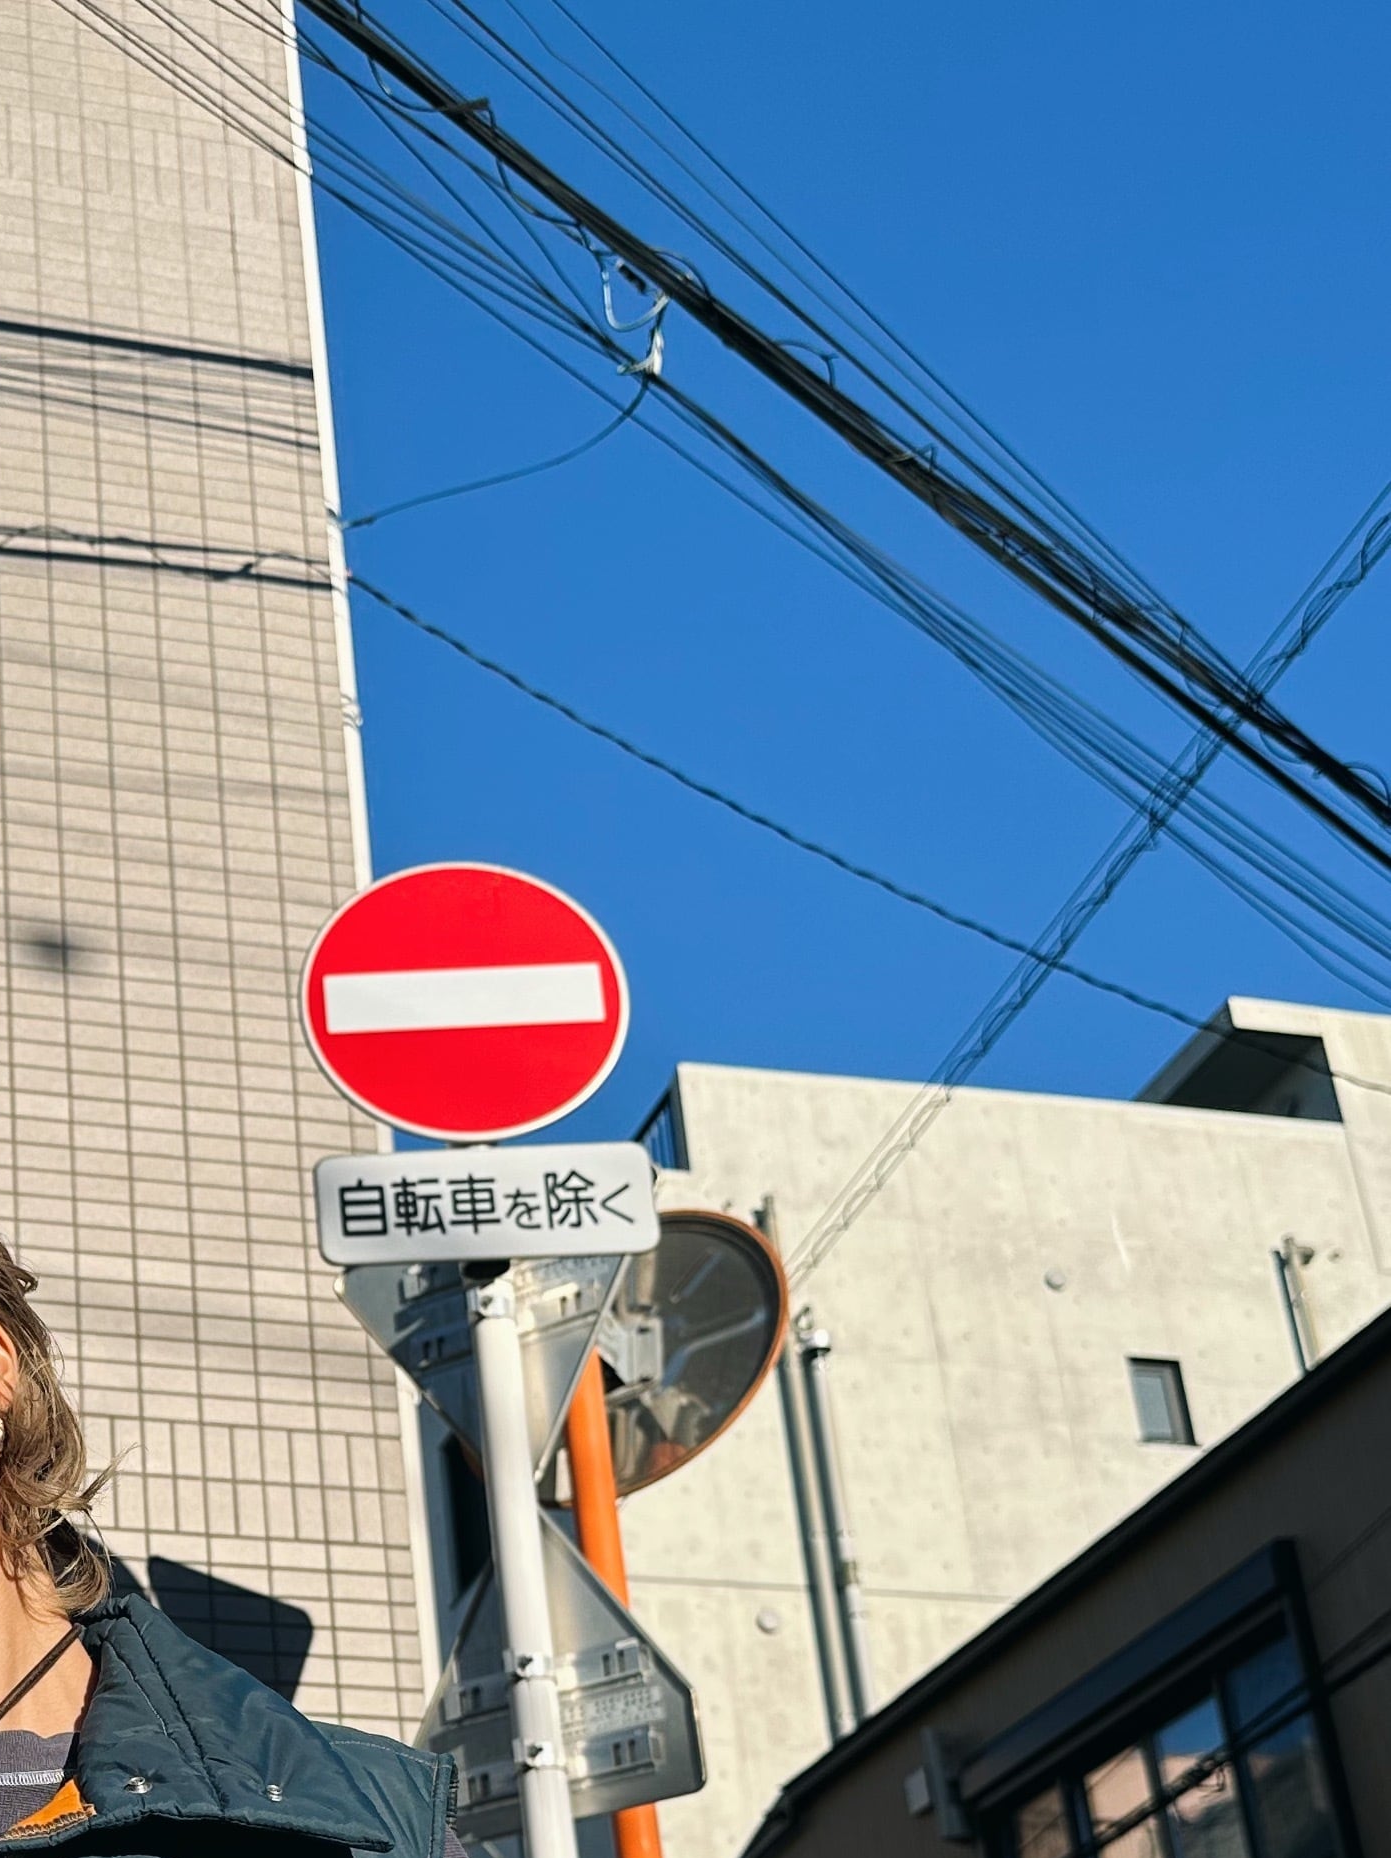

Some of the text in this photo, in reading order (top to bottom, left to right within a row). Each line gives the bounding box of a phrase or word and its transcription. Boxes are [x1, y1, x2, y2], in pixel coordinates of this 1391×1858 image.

[338, 1169, 635, 1238] 自転車を除く
